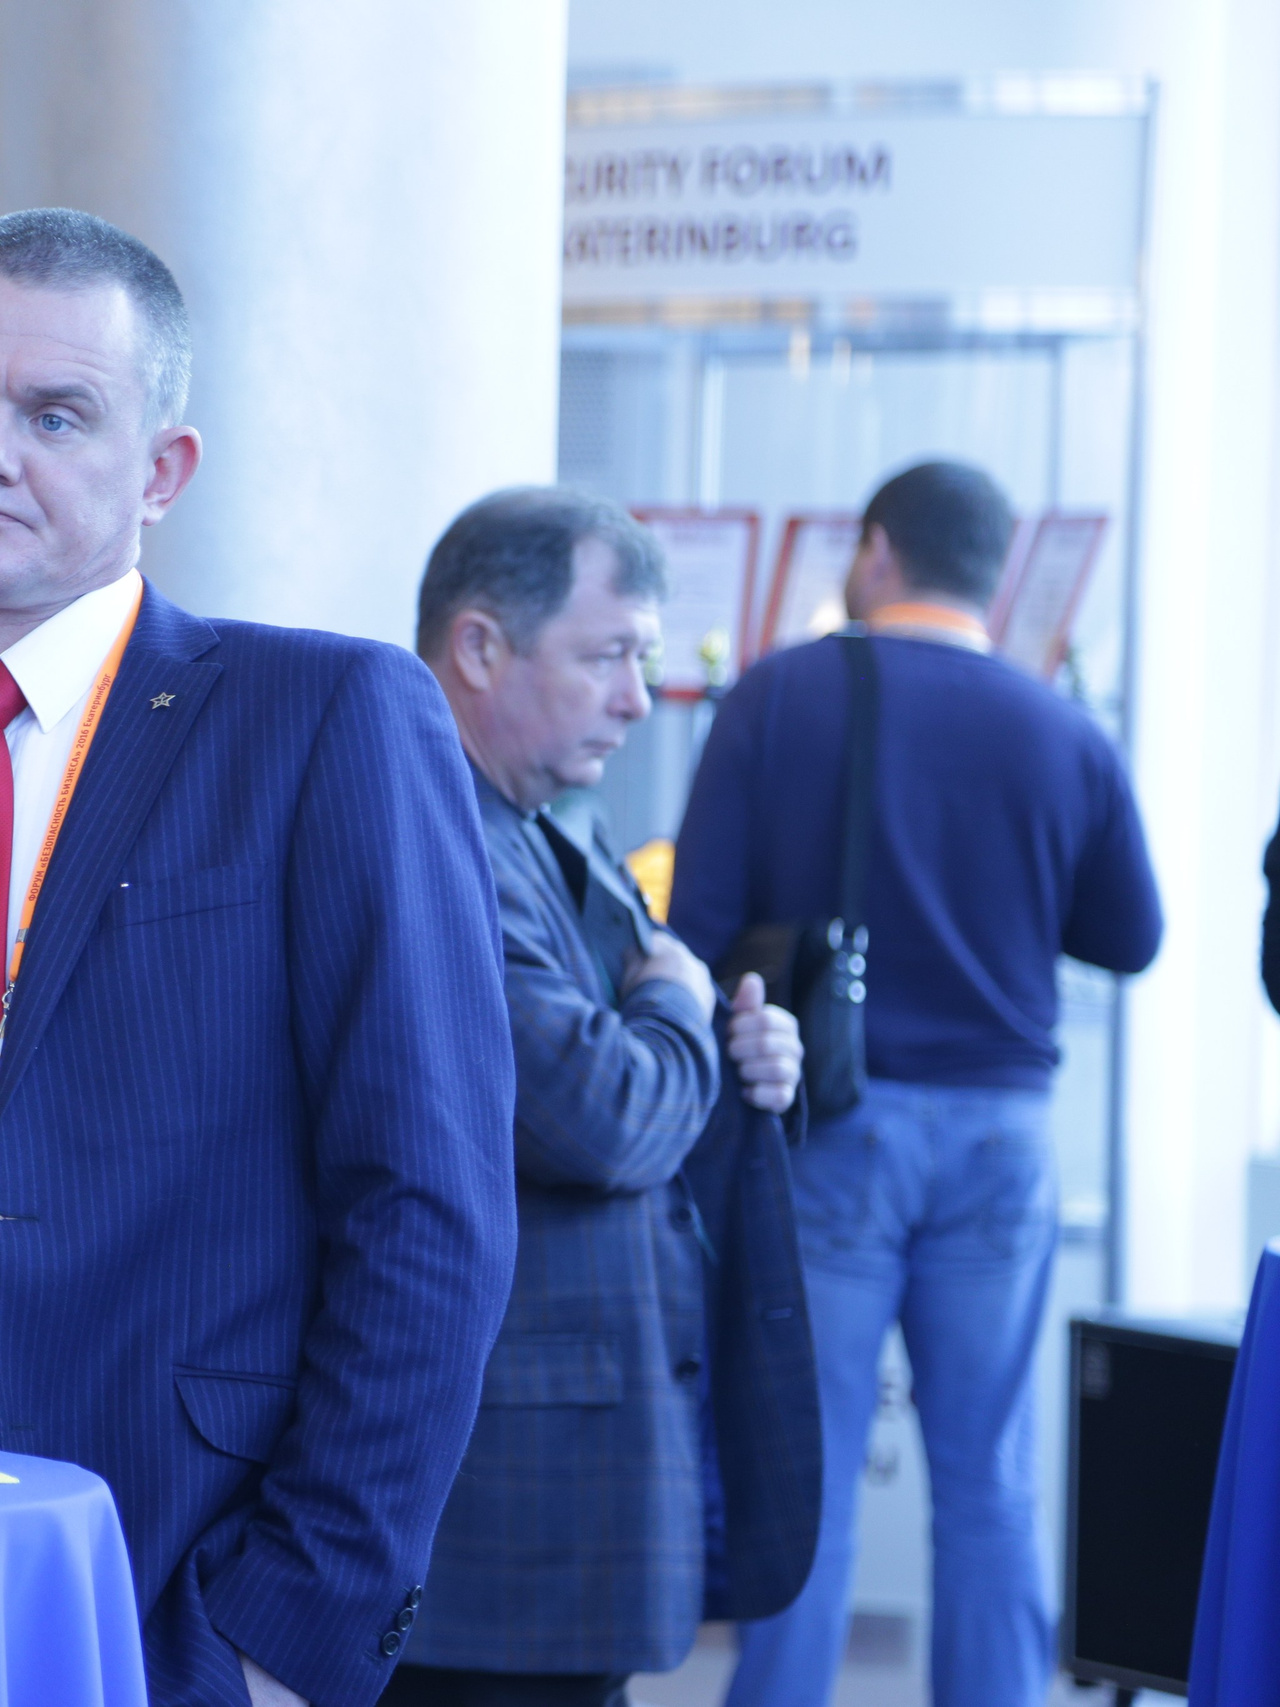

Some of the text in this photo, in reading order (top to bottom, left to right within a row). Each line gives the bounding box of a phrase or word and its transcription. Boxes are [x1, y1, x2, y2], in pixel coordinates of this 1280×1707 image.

[565, 142, 892, 199] URITY FORUM
[28, 870, 44, 901] ФОРУМ
[76, 729, 90, 749] 2016
[83, 674, 111, 727] Екатеринбург
